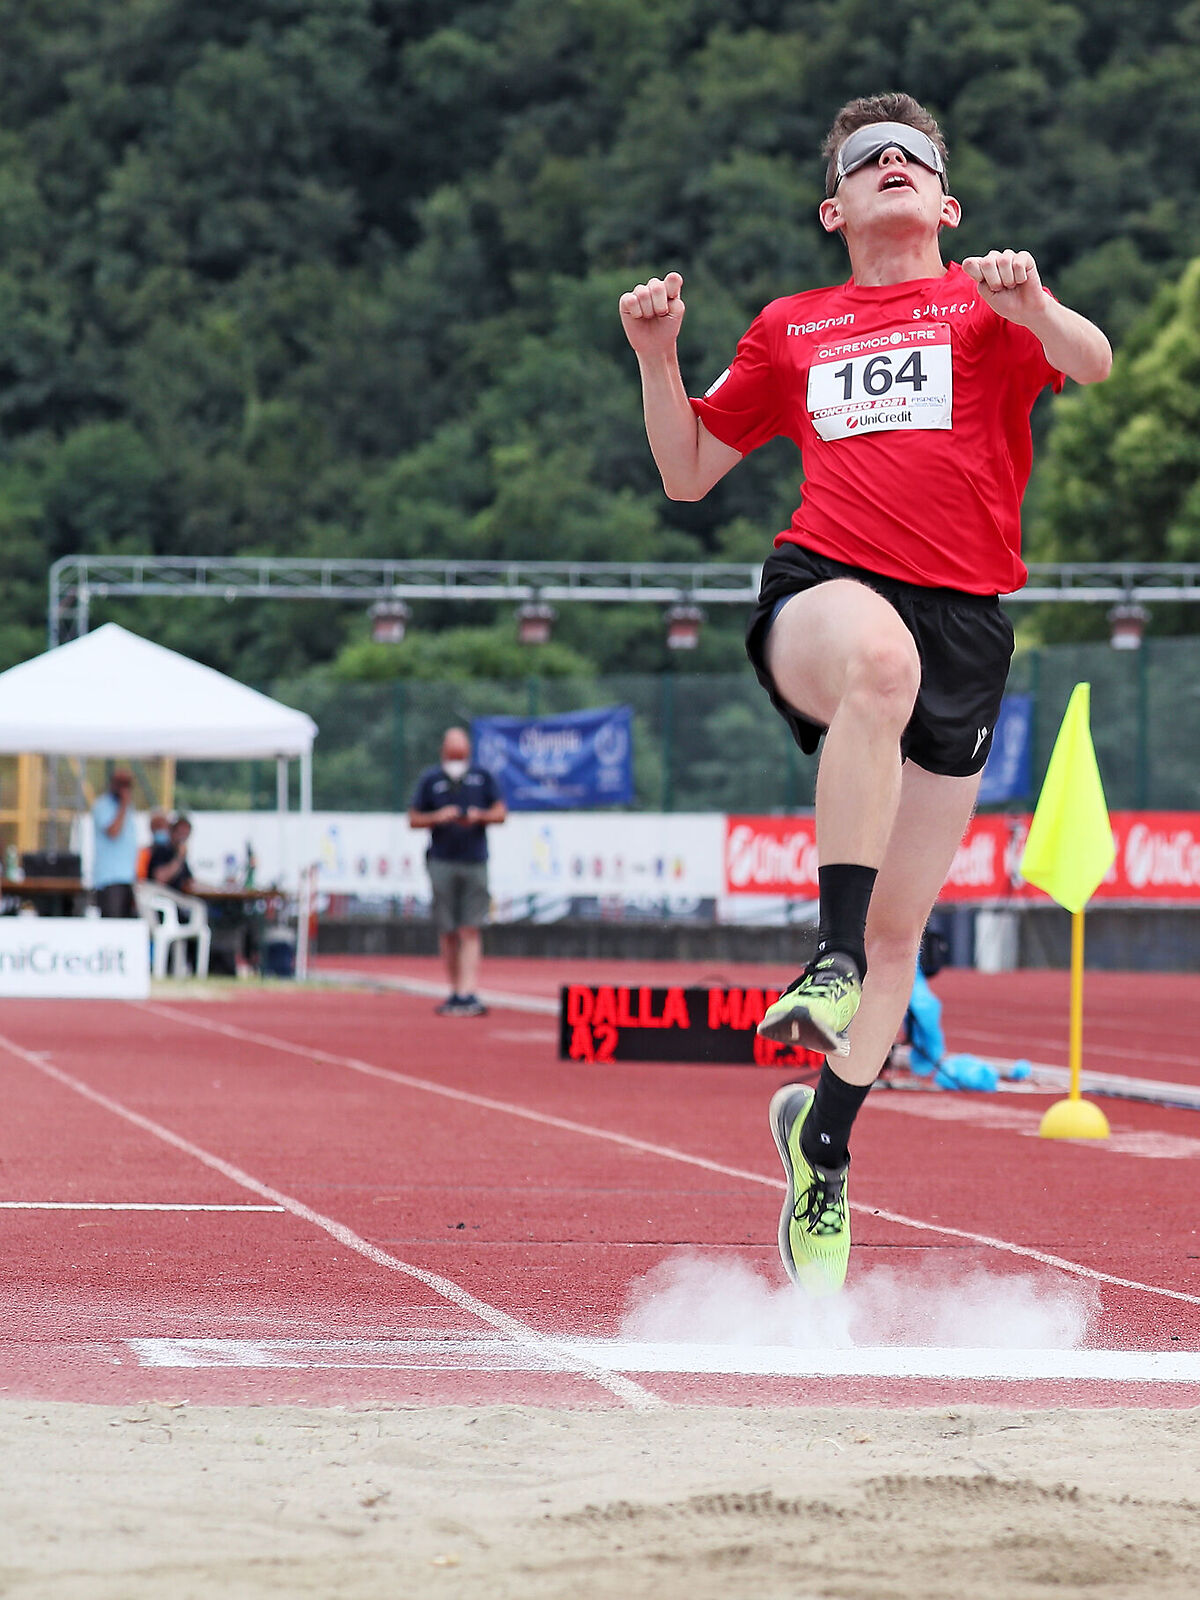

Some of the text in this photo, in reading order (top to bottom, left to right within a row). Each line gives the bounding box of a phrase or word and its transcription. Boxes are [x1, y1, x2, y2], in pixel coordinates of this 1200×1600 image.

[834, 350, 927, 401] 164
[860, 411, 912, 426] UniCredit
[567, 984, 690, 1029] DALLA
[568, 1026, 619, 1065] A2
